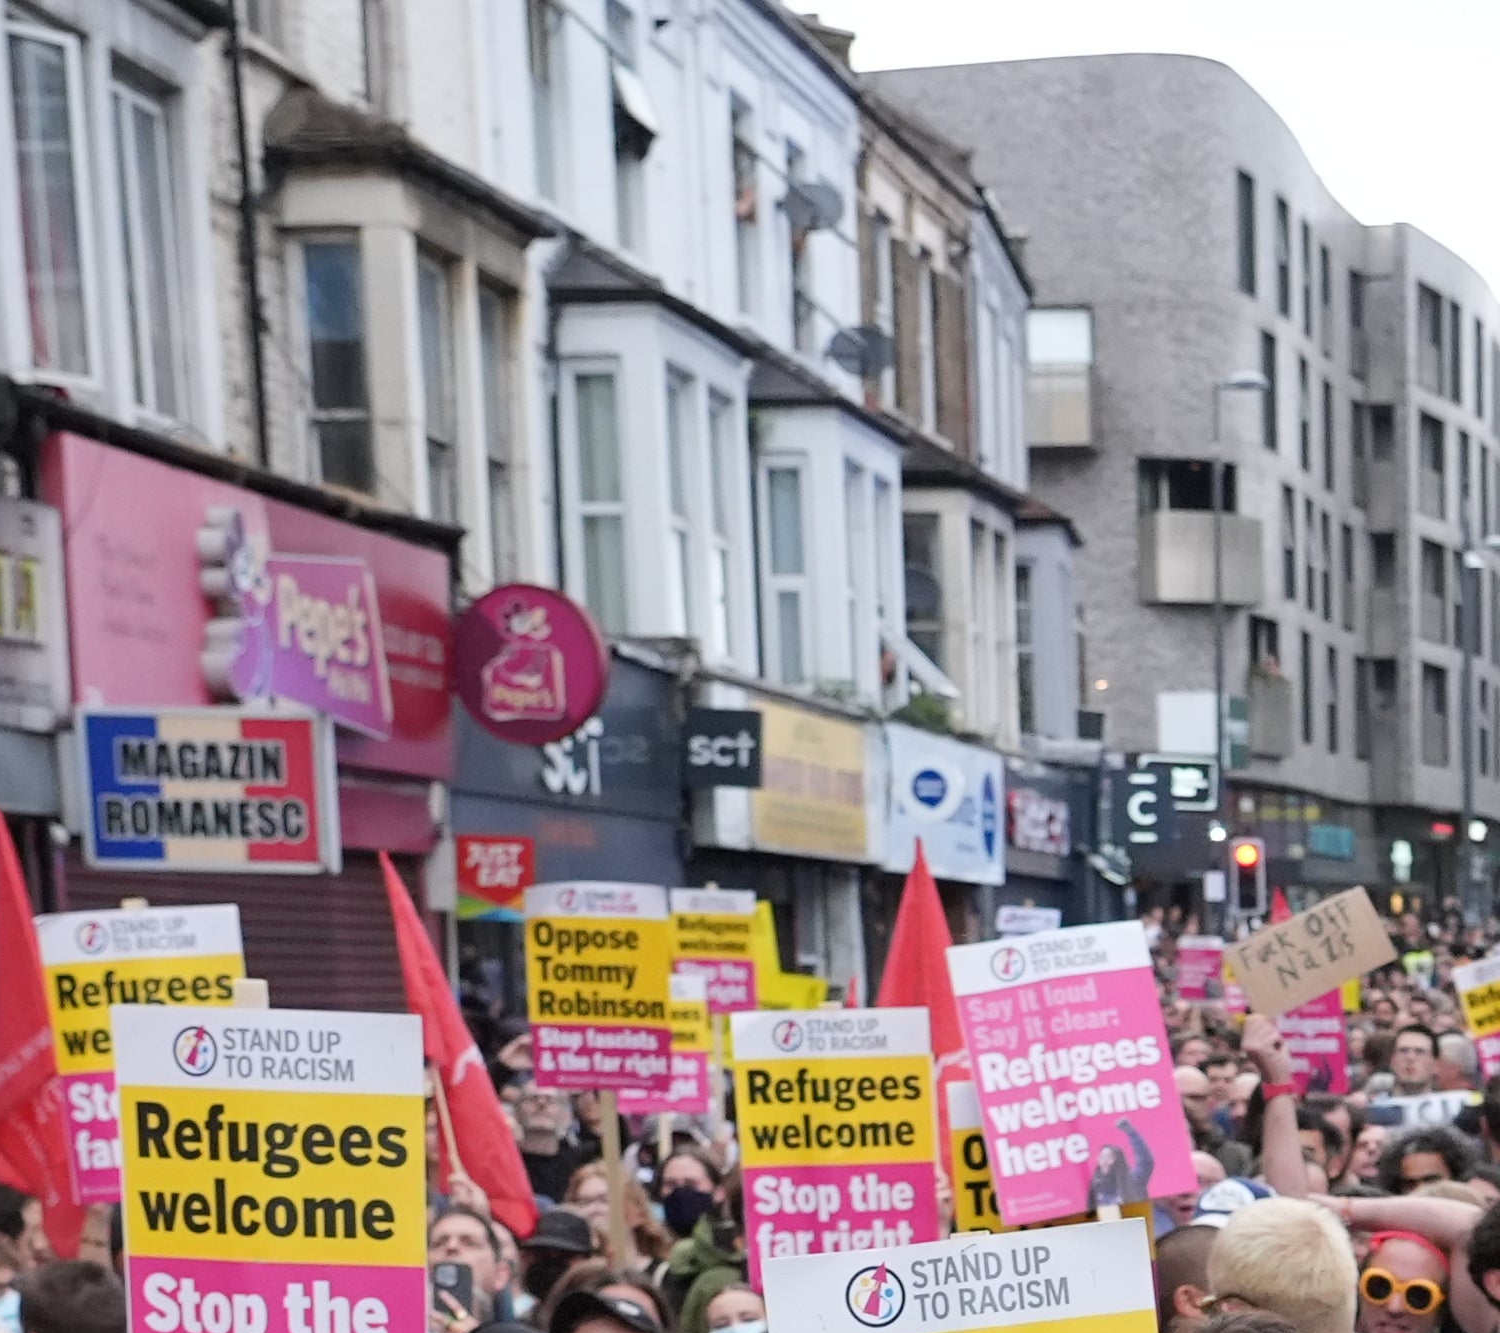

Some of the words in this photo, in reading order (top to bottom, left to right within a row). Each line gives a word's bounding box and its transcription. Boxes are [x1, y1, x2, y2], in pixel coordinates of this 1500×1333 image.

[119, 740, 285, 784] MAGAZIN
[103, 795, 304, 842] ROMANESC
[462, 843, 525, 871] JUST
[475, 865, 519, 888] EAT
[533, 920, 639, 954] Oppose
[536, 957, 637, 991] Tommy
[538, 990, 665, 1020] Robinson
[967, 996, 1014, 1023] Say
[1019, 985, 1040, 1010] it
[1045, 979, 1097, 1006] loud
[538, 1028, 583, 1051] Stop
[585, 1028, 659, 1050] fascists
[973, 1022, 1019, 1049] Say
[1026, 1014, 1047, 1037] it
[1049, 1007, 1120, 1034] clear:
[540, 1054, 555, 1072] &
[557, 1053, 590, 1072] the
[593, 1054, 621, 1072] far
[624, 1053, 671, 1076] right
[978, 1034, 1161, 1095] Refugees
[746, 1068, 922, 1111] Refugees
[987, 1079, 1161, 1133] welcome
[135, 1100, 407, 1179] Refugees
[751, 1116, 915, 1151] welcome
[1001, 1133, 1089, 1178] here
[140, 1178, 395, 1241] welcome
[753, 1175, 840, 1215] Stop
[849, 1173, 914, 1210] the
[910, 1250, 1003, 1290] STAND
[1011, 1246, 1052, 1278] UP
[914, 1294, 950, 1322] TO
[959, 1276, 1070, 1317] RACISM
